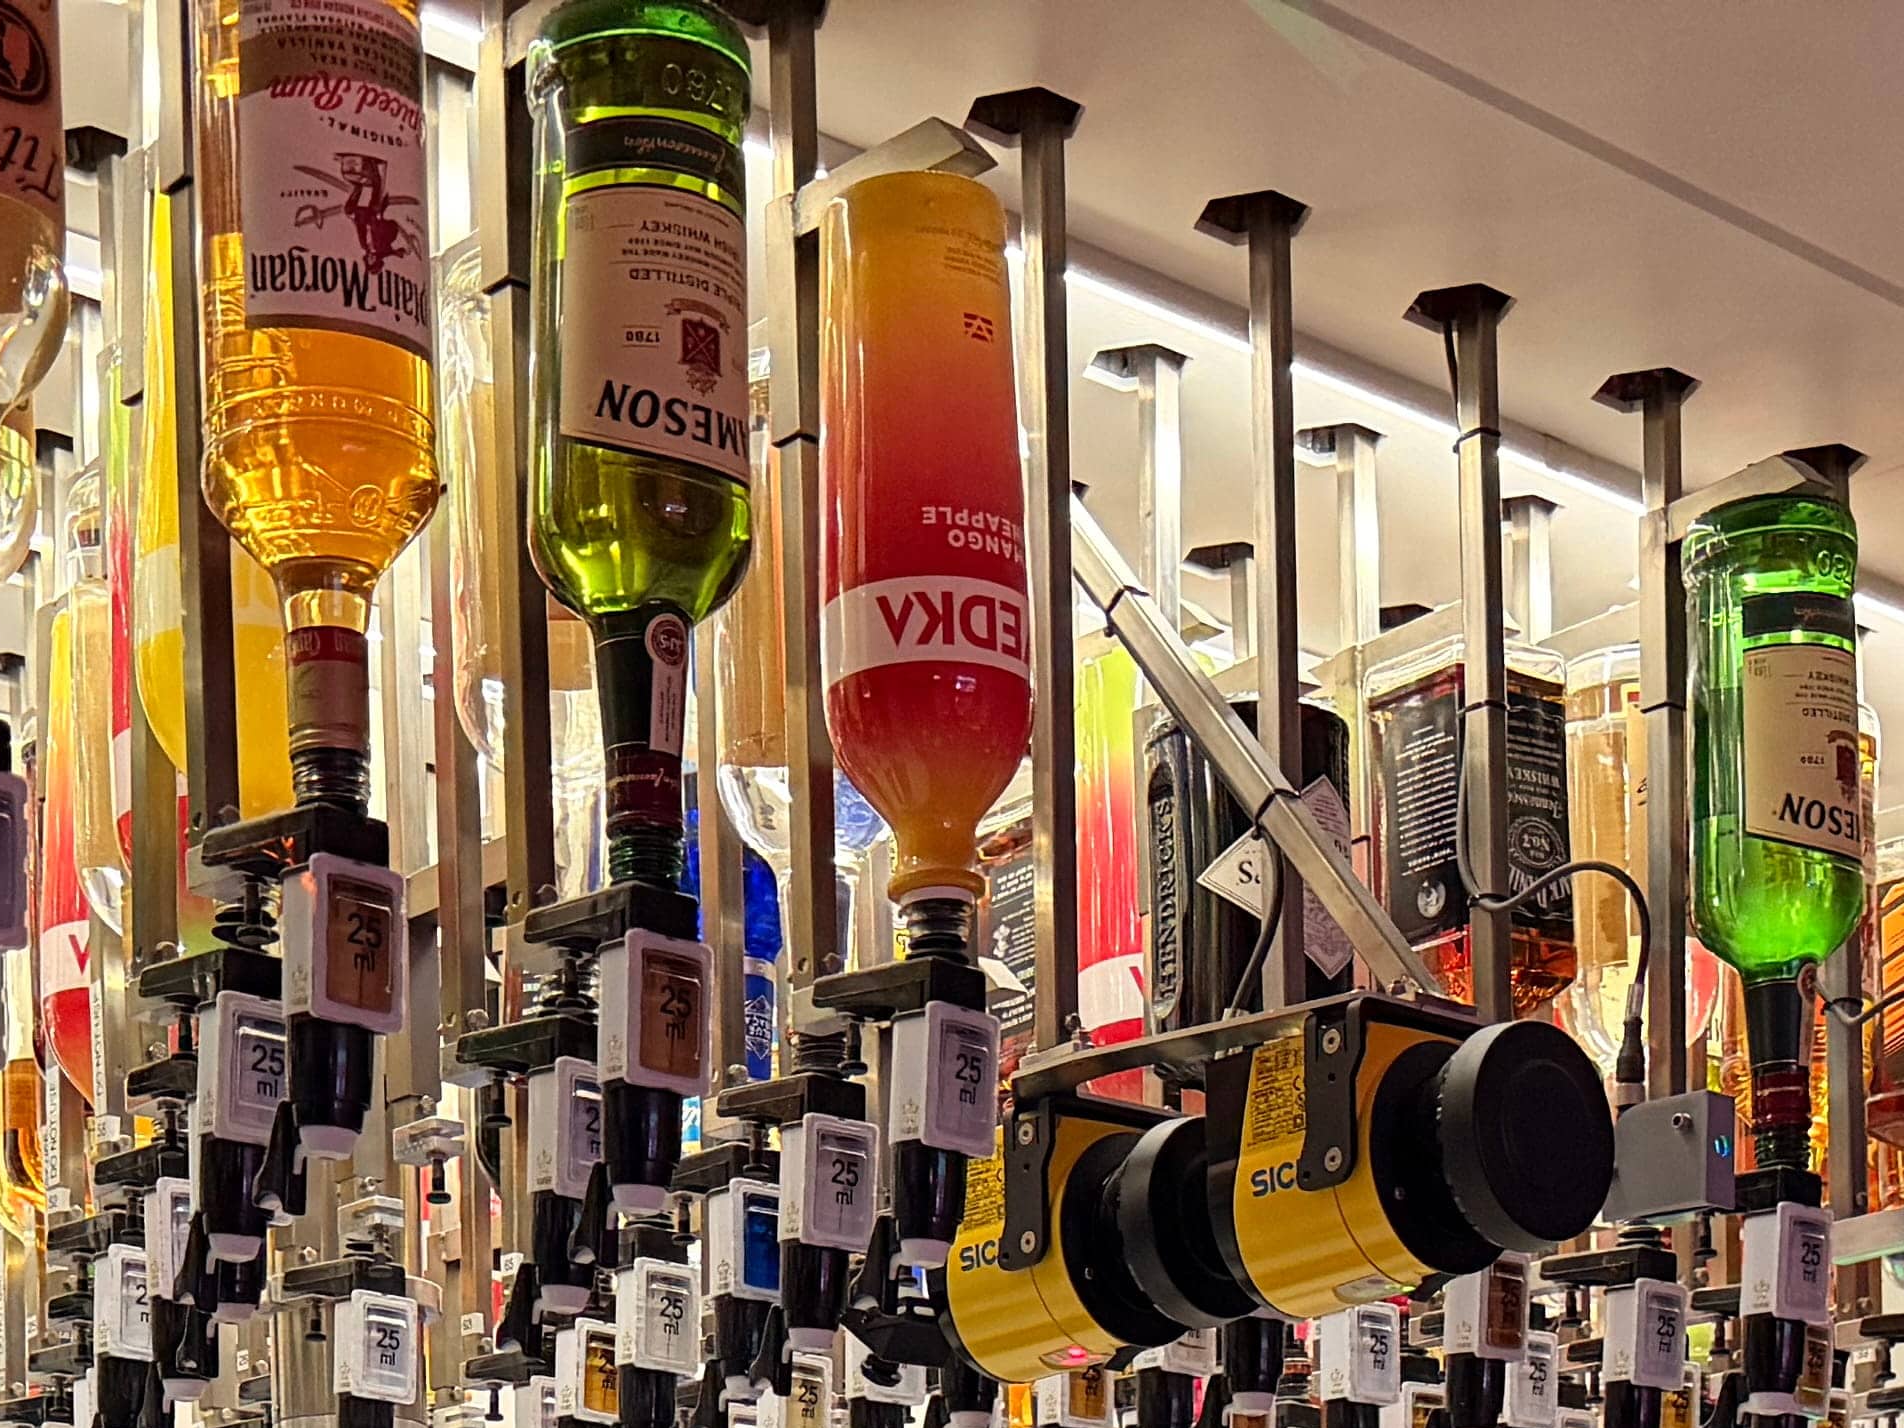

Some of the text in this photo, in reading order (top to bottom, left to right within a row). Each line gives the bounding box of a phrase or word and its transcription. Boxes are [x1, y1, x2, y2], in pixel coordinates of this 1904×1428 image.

[267, 72, 426, 133] piced Rum
[640, 220, 710, 246] WHISKEY
[250, 246, 429, 328] ptain Morgan
[629, 268, 710, 292] DISTILLED
[595, 379, 748, 458] AMESON
[920, 506, 1016, 541] EAPPLE
[946, 528, 1018, 560] ANGO
[876, 590, 1022, 658] EDKA
[1778, 792, 1860, 845] ESON
[347, 912, 383, 947] 25
[354, 950, 375, 973] ml
[660, 984, 693, 1016] 25
[665, 1016, 687, 1041] ml
[251, 1046, 283, 1075] 25
[954, 1052, 982, 1082] 25
[46, 1120, 58, 1155] NOT
[832, 1159, 858, 1186] 25
[1251, 1161, 1298, 1198] SIC
[959, 1239, 997, 1272] SIC
[1801, 1242, 1821, 1266] 25
[660, 1298, 683, 1320] 25
[376, 1328, 399, 1351] 25
[1657, 1316, 1676, 1337] 25
[1369, 1334, 1388, 1356] 25
[1528, 1361, 1546, 1382] 25
[798, 1385, 818, 1405] 25
